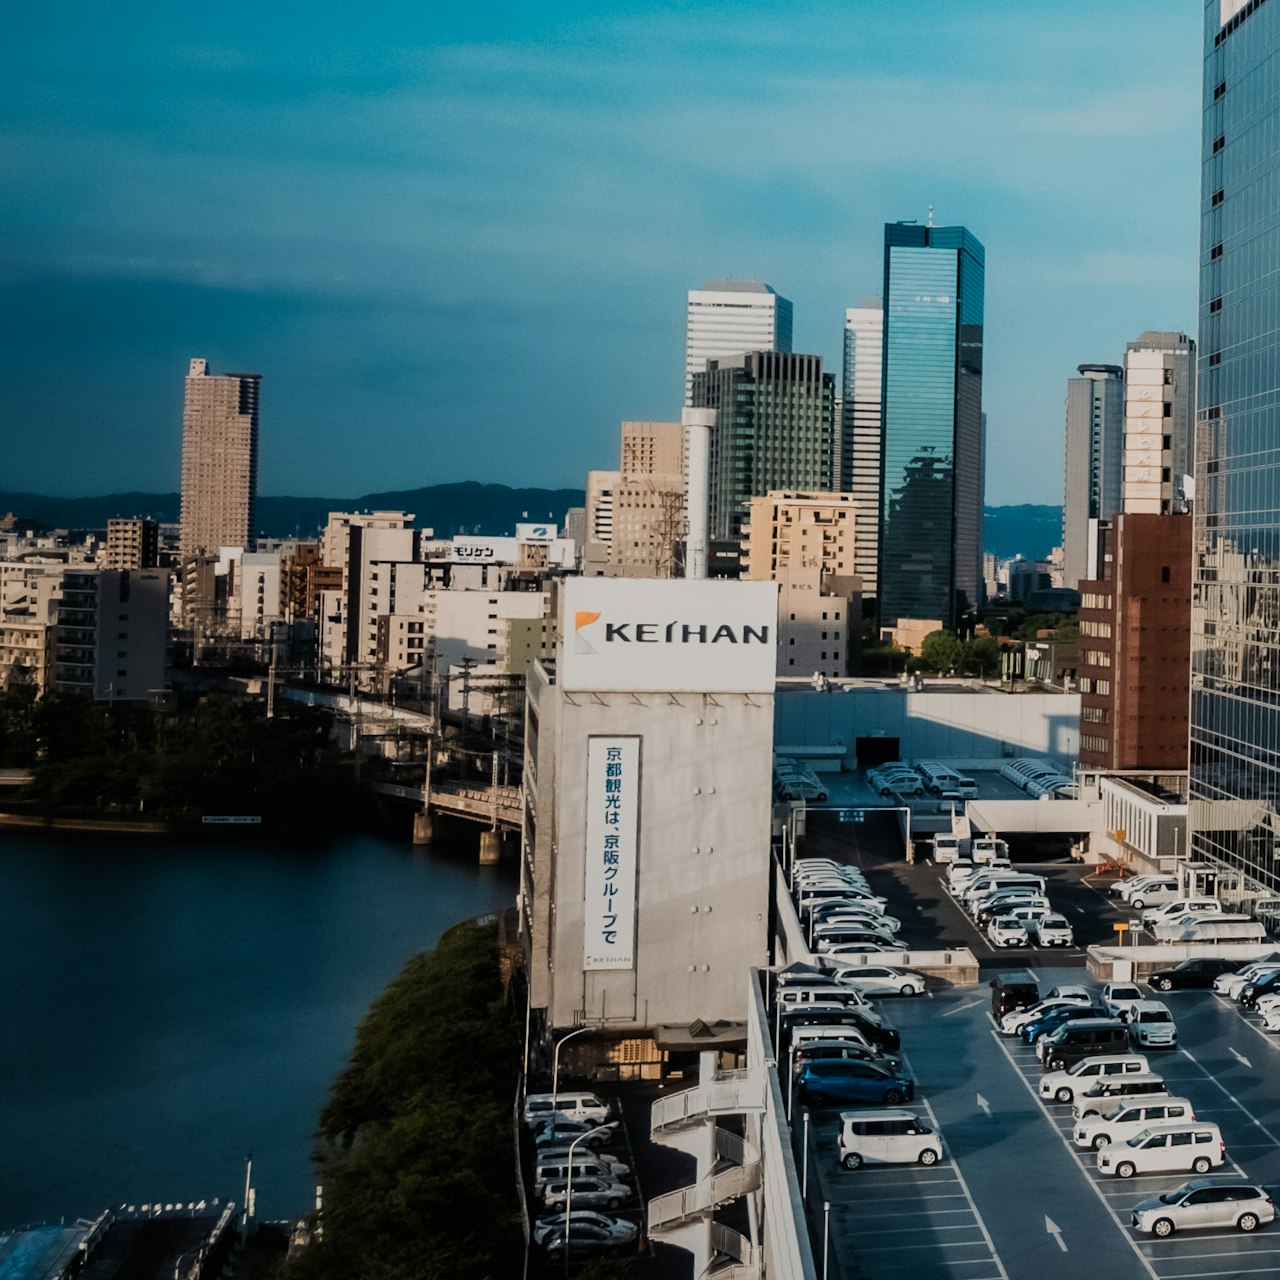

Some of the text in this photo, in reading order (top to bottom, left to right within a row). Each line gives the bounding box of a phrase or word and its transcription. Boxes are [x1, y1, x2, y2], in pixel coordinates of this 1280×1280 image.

[454, 547, 494, 557] モリケン
[605, 620, 769, 645] KEIHAN
[601, 746, 622, 945] 京都観光は、京阪グループで
